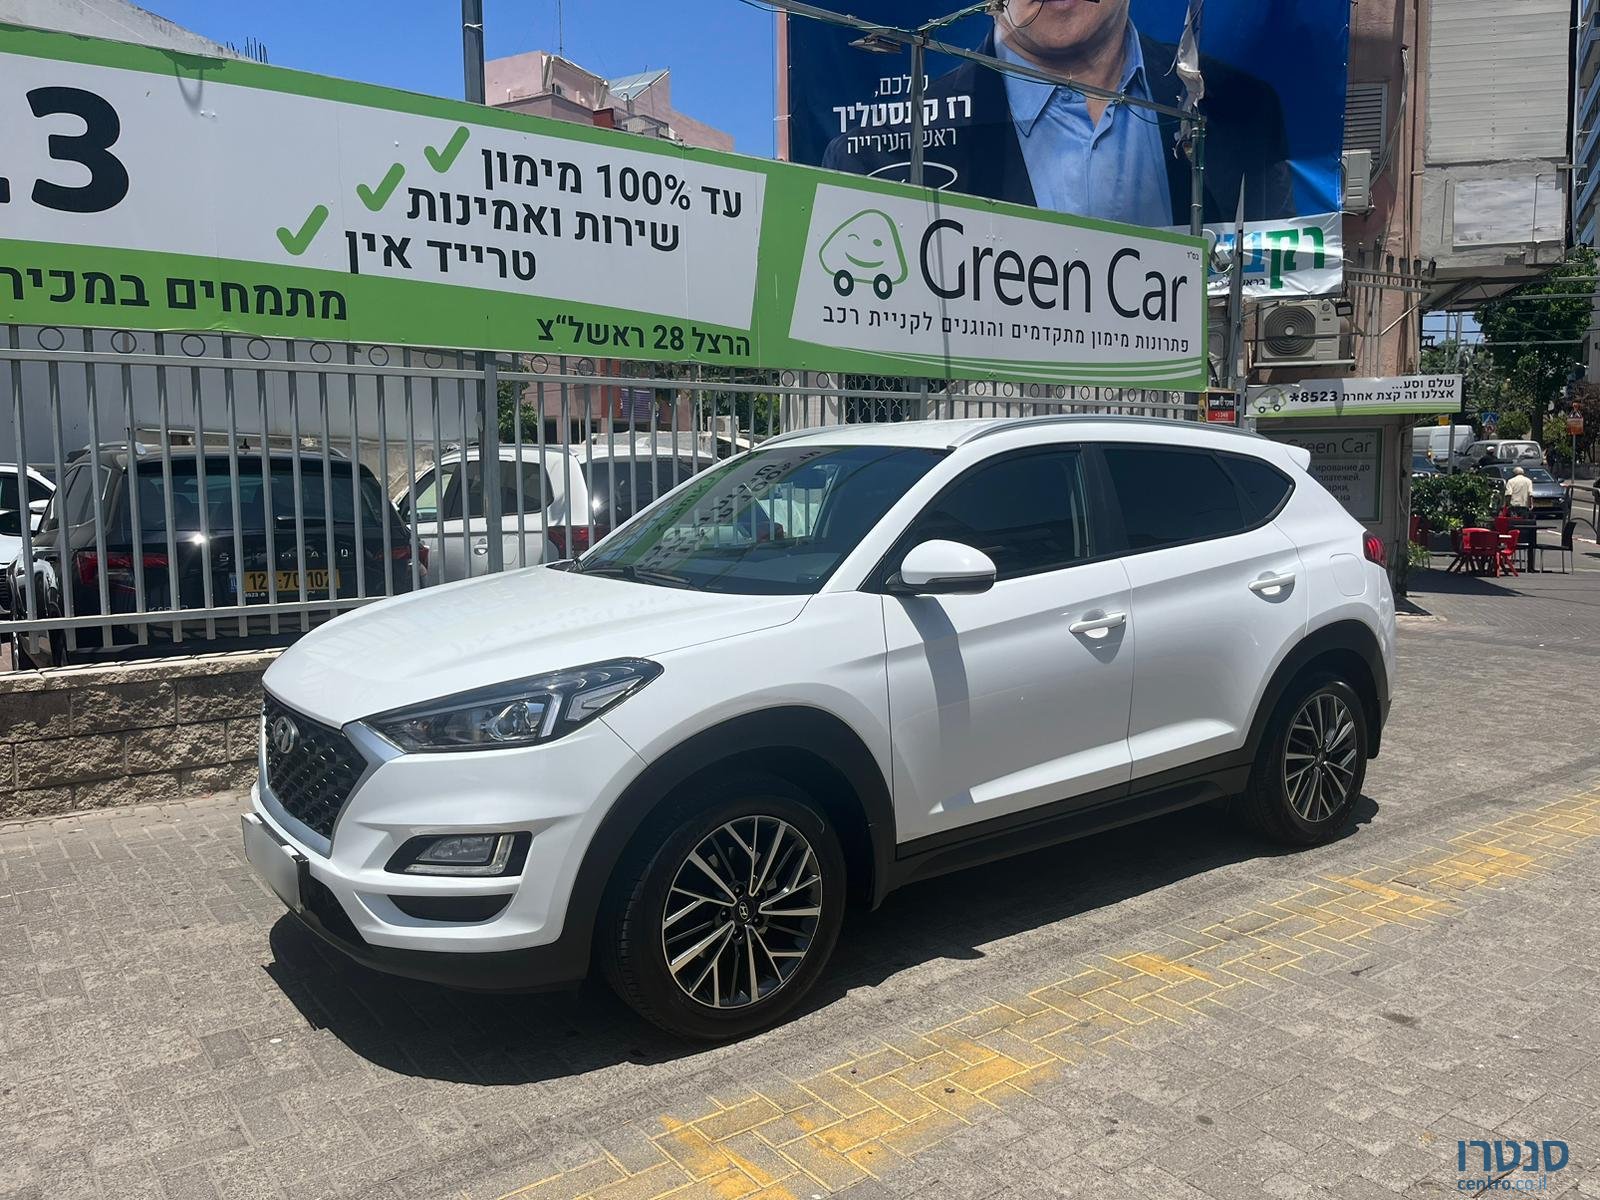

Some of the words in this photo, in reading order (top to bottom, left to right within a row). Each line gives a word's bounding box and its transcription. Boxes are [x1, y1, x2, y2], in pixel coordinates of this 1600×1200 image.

[832, 98, 939, 133] קנסטליך
[946, 95, 972, 119] רז
[847, 131, 911, 154] העירייה
[481, 148, 582, 194] מימון
[596, 164, 691, 211] 100%
[406, 186, 561, 238] ואמינות
[701, 185, 742, 218] עד
[574, 210, 680, 252] שירות
[345, 230, 413, 275] אין
[426, 238, 537, 281] טרייד
[919, 218, 1091, 313] Green
[1107, 247, 1188, 323] Car
[166, 277, 347, 321] מתמחים
[823, 305, 859, 325] רכב
[868, 311, 933, 335] לקניית
[941, 316, 1003, 338] והוגנים
[653, 325, 685, 352] 28
[691, 326, 750, 357] הרצל
[1011, 323, 1085, 346] מתקדמים
[1091, 330, 1129, 349] מימון
[1135, 335, 1189, 353] פתרונות
[1404, 389, 1418, 399] זה
[1421, 388, 1455, 398] אצלנו
[1428, 378, 1455, 389] שלם
[1342, 392, 1373, 402] אחרת
[1376, 390, 1400, 402] קצת
[1341, 437, 1372, 454] Car
